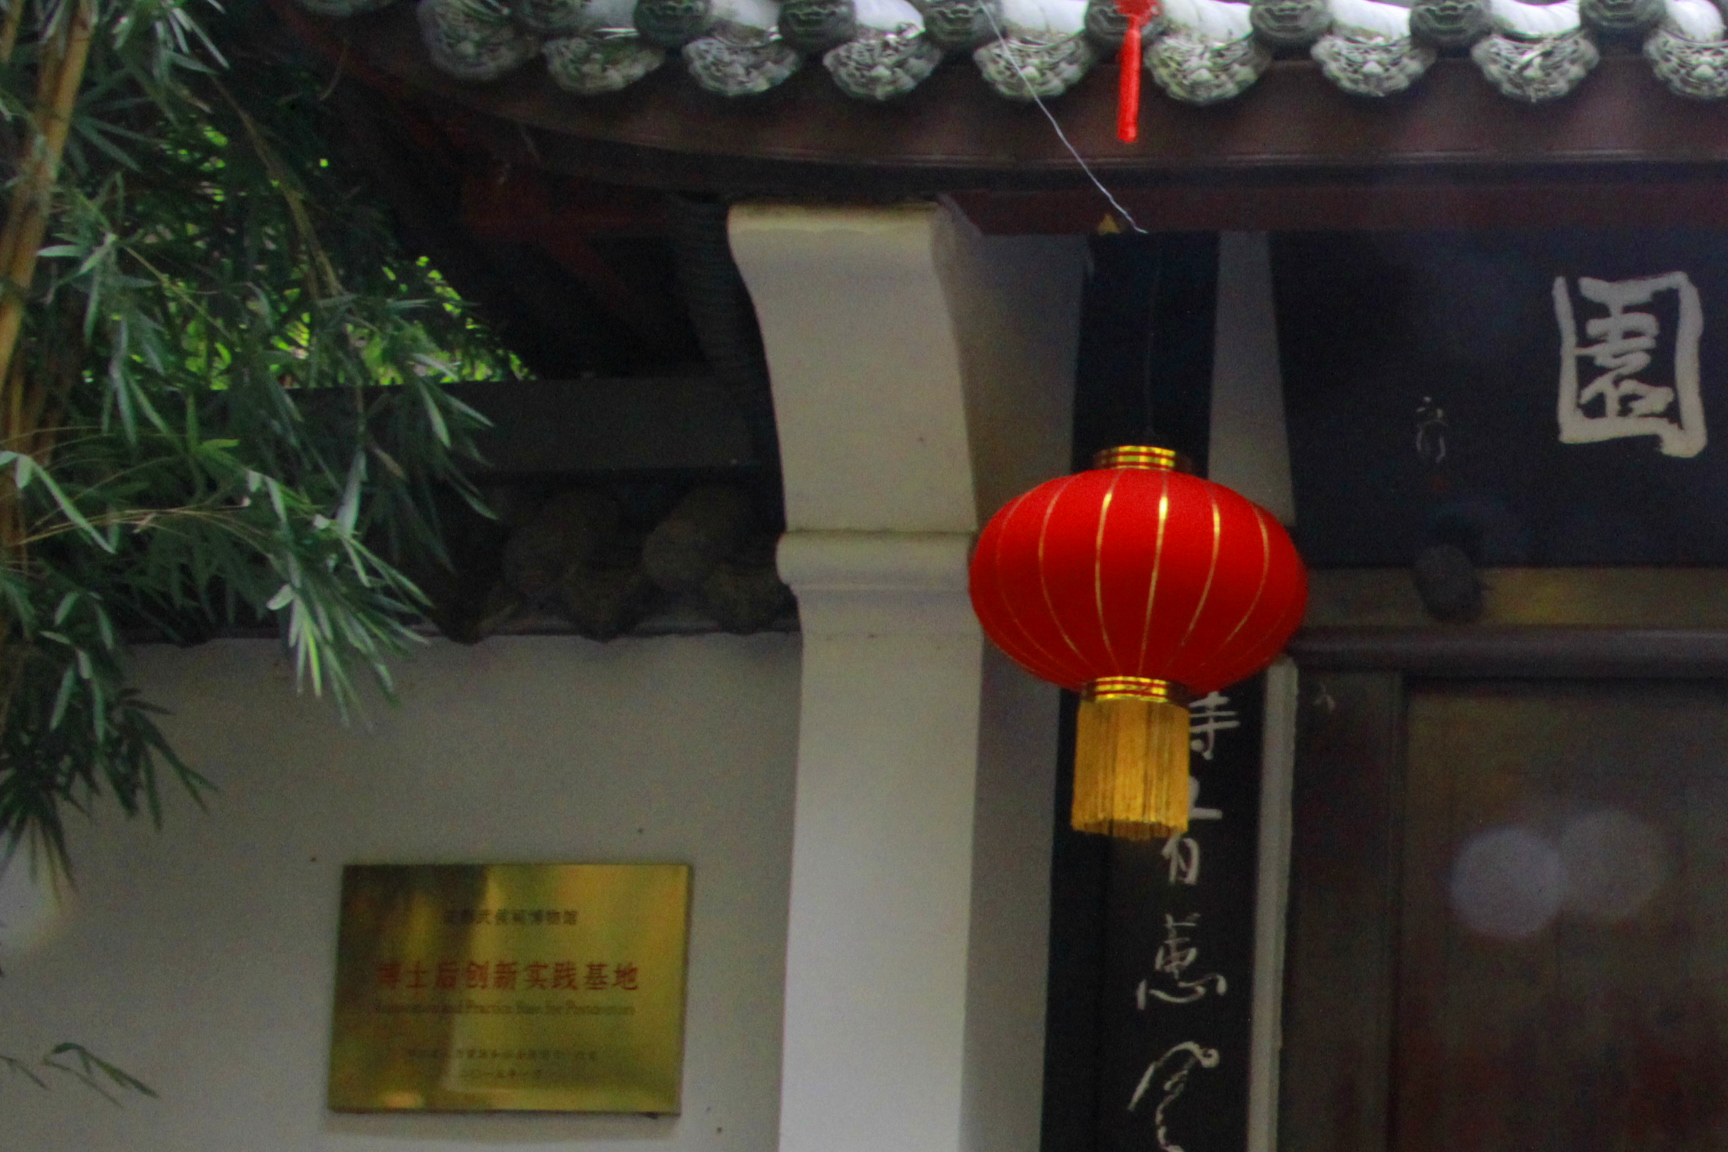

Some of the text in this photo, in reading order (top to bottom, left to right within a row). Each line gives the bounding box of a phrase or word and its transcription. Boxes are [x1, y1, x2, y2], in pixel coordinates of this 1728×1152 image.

[376, 960, 640, 993] 博士后创新实践基地
